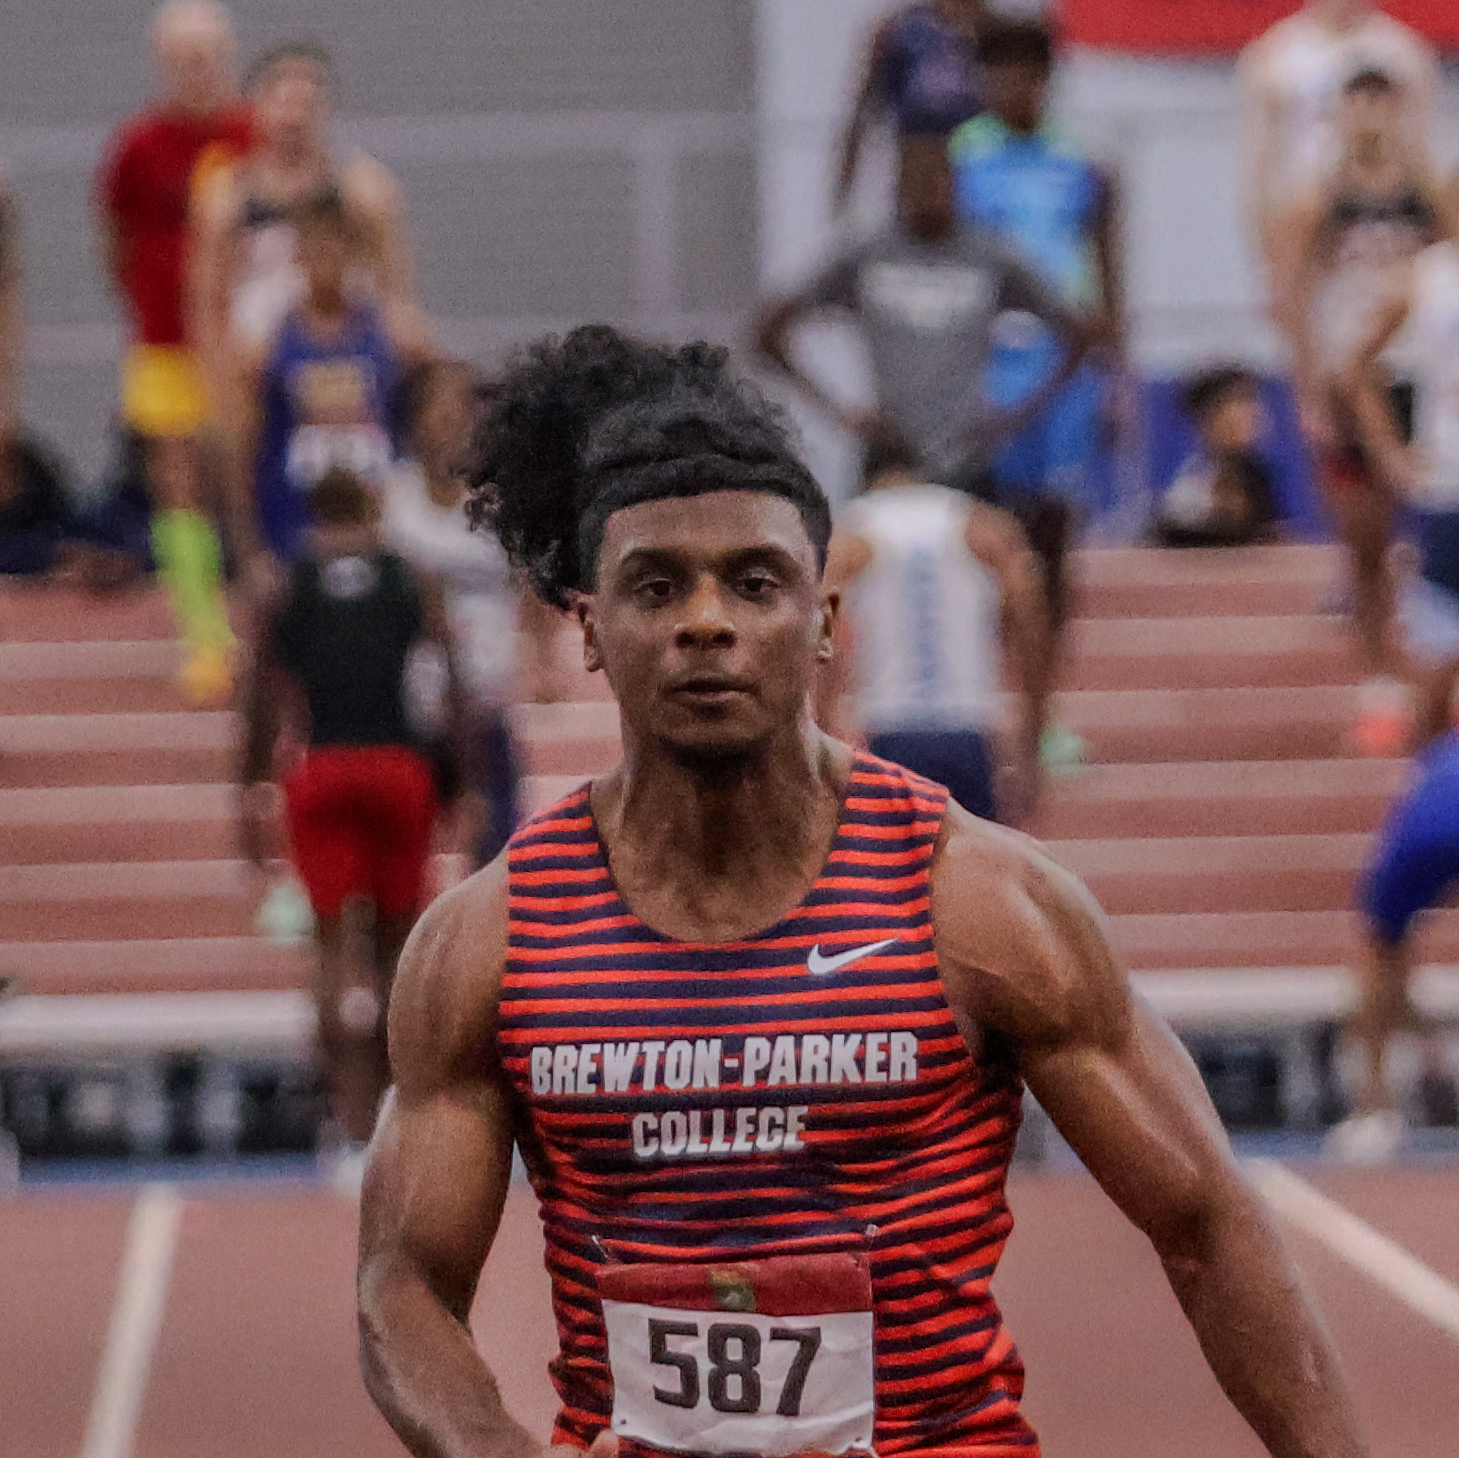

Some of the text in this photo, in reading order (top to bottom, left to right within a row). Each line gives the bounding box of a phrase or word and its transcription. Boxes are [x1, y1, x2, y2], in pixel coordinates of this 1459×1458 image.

[530, 1031, 920, 1095] BREWTON-PARKER
[632, 1105, 809, 1157] COLLEGE
[647, 1317, 823, 1417] 587
